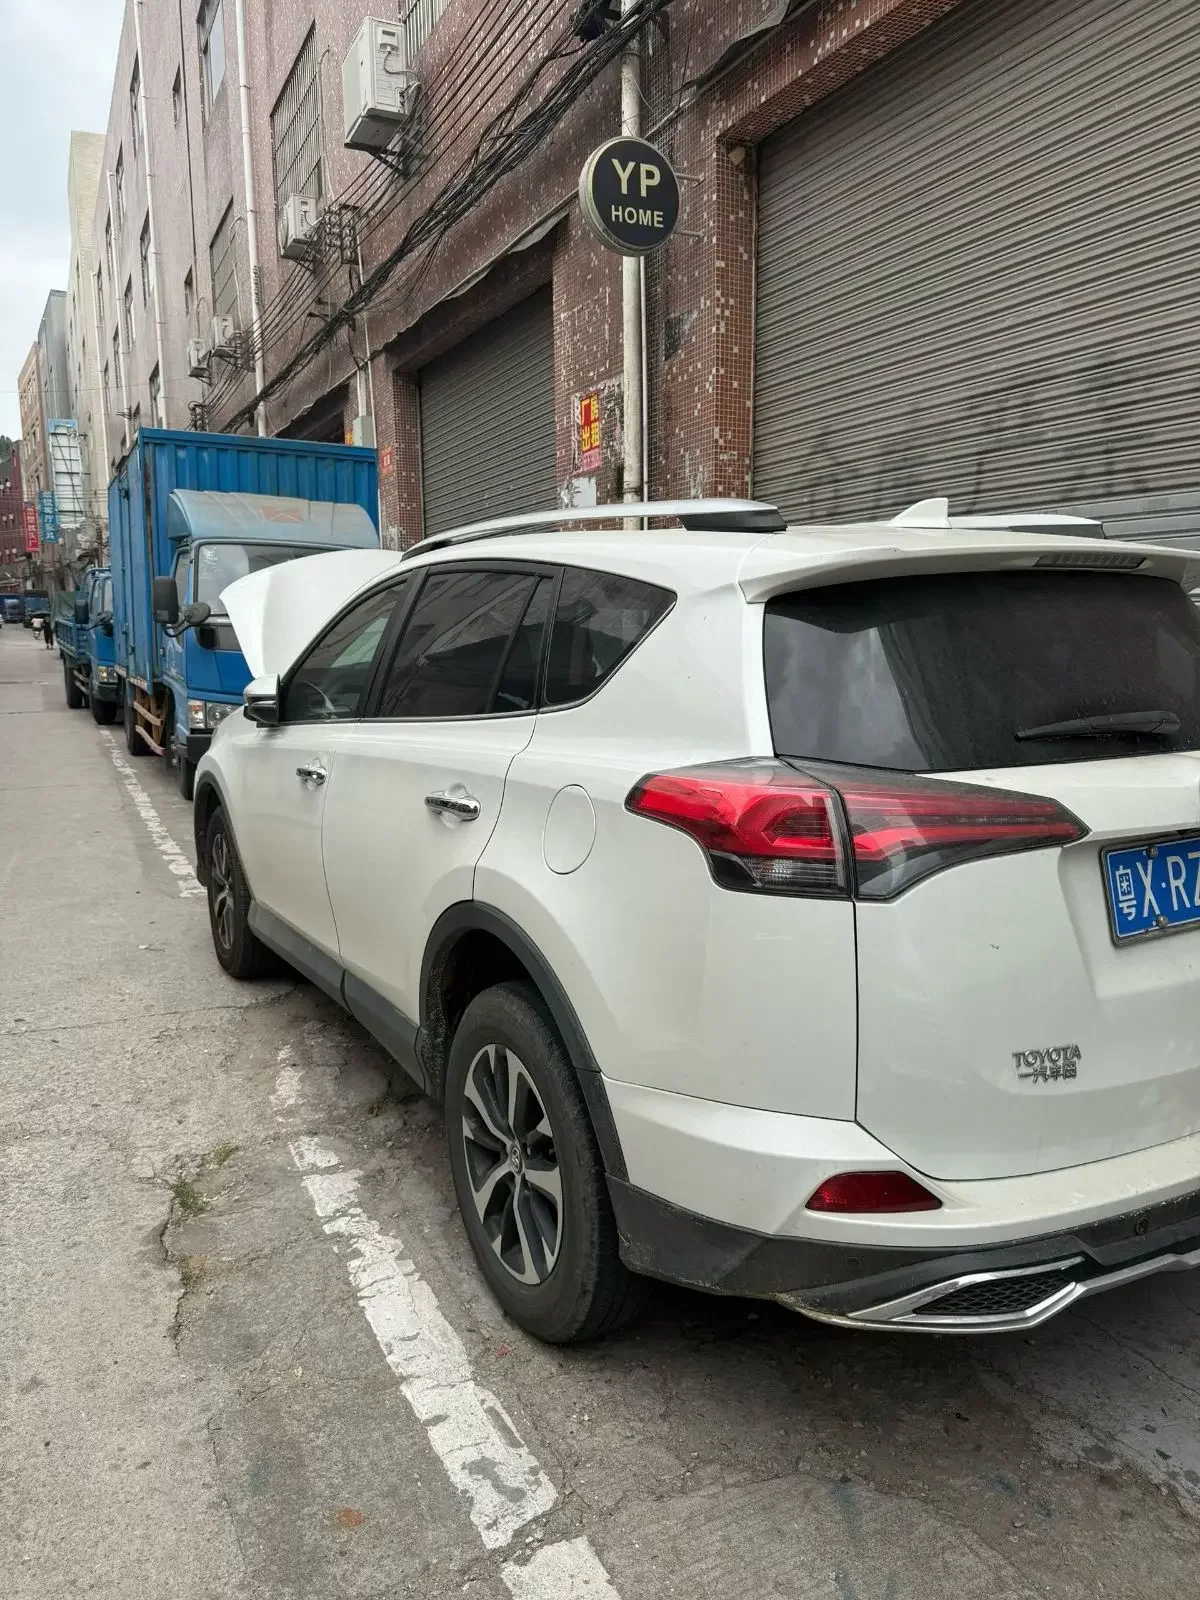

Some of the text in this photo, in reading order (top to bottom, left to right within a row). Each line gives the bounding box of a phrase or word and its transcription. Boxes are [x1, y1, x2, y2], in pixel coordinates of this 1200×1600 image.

[611, 158, 661, 197] YP
[611, 205, 664, 228] HOME
[581, 421, 600, 452] 出租
[1012, 1044, 1081, 1068] TOYOTA
